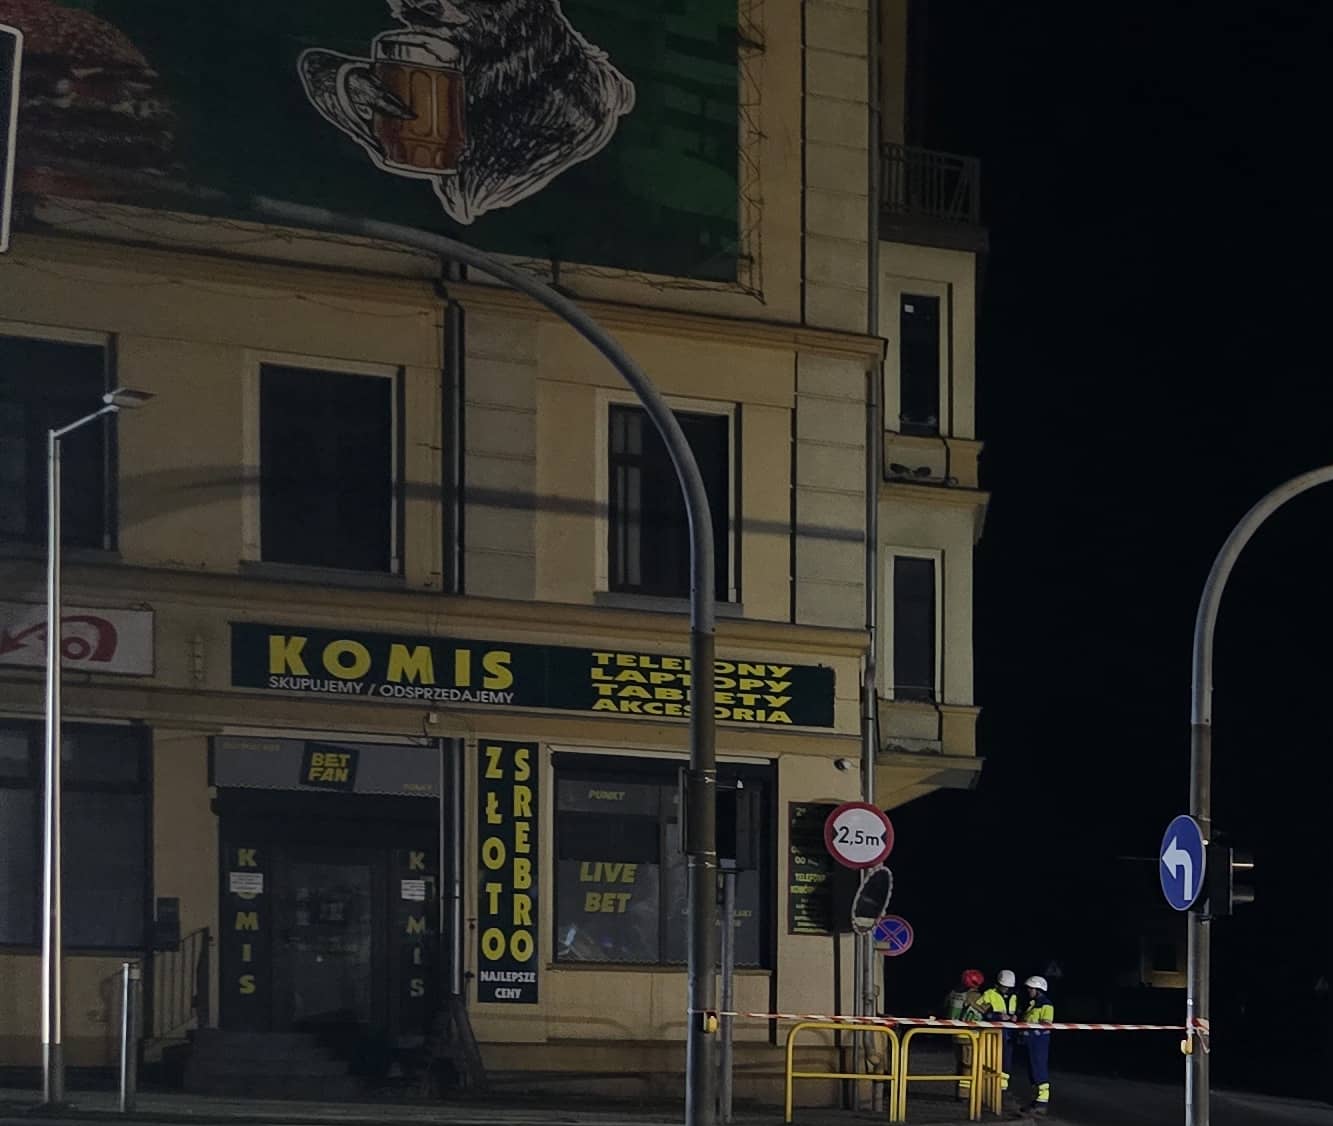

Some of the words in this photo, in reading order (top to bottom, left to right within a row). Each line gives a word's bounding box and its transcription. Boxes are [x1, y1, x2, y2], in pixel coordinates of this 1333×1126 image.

[269, 634, 513, 690] KOMIS
[591, 652, 792, 678] TELEONY
[270, 675, 364, 694] SKUPUJEMY
[379, 685, 514, 704] ODSPRZEDAJEMY
[592, 683, 792, 708] TABETY
[311, 752, 351, 768] BET
[307, 767, 349, 782] FAN
[481, 746, 507, 961] ZŁOTO
[510, 748, 535, 963] SREBRO
[579, 861, 638, 884] LIVE
[584, 892, 632, 913] BET
[235, 848, 260, 995] KMIS
[405, 850, 426, 998] KMIS
[480, 971, 536, 983] NAJLEPSZE
[494, 988, 522, 1000] CENY
